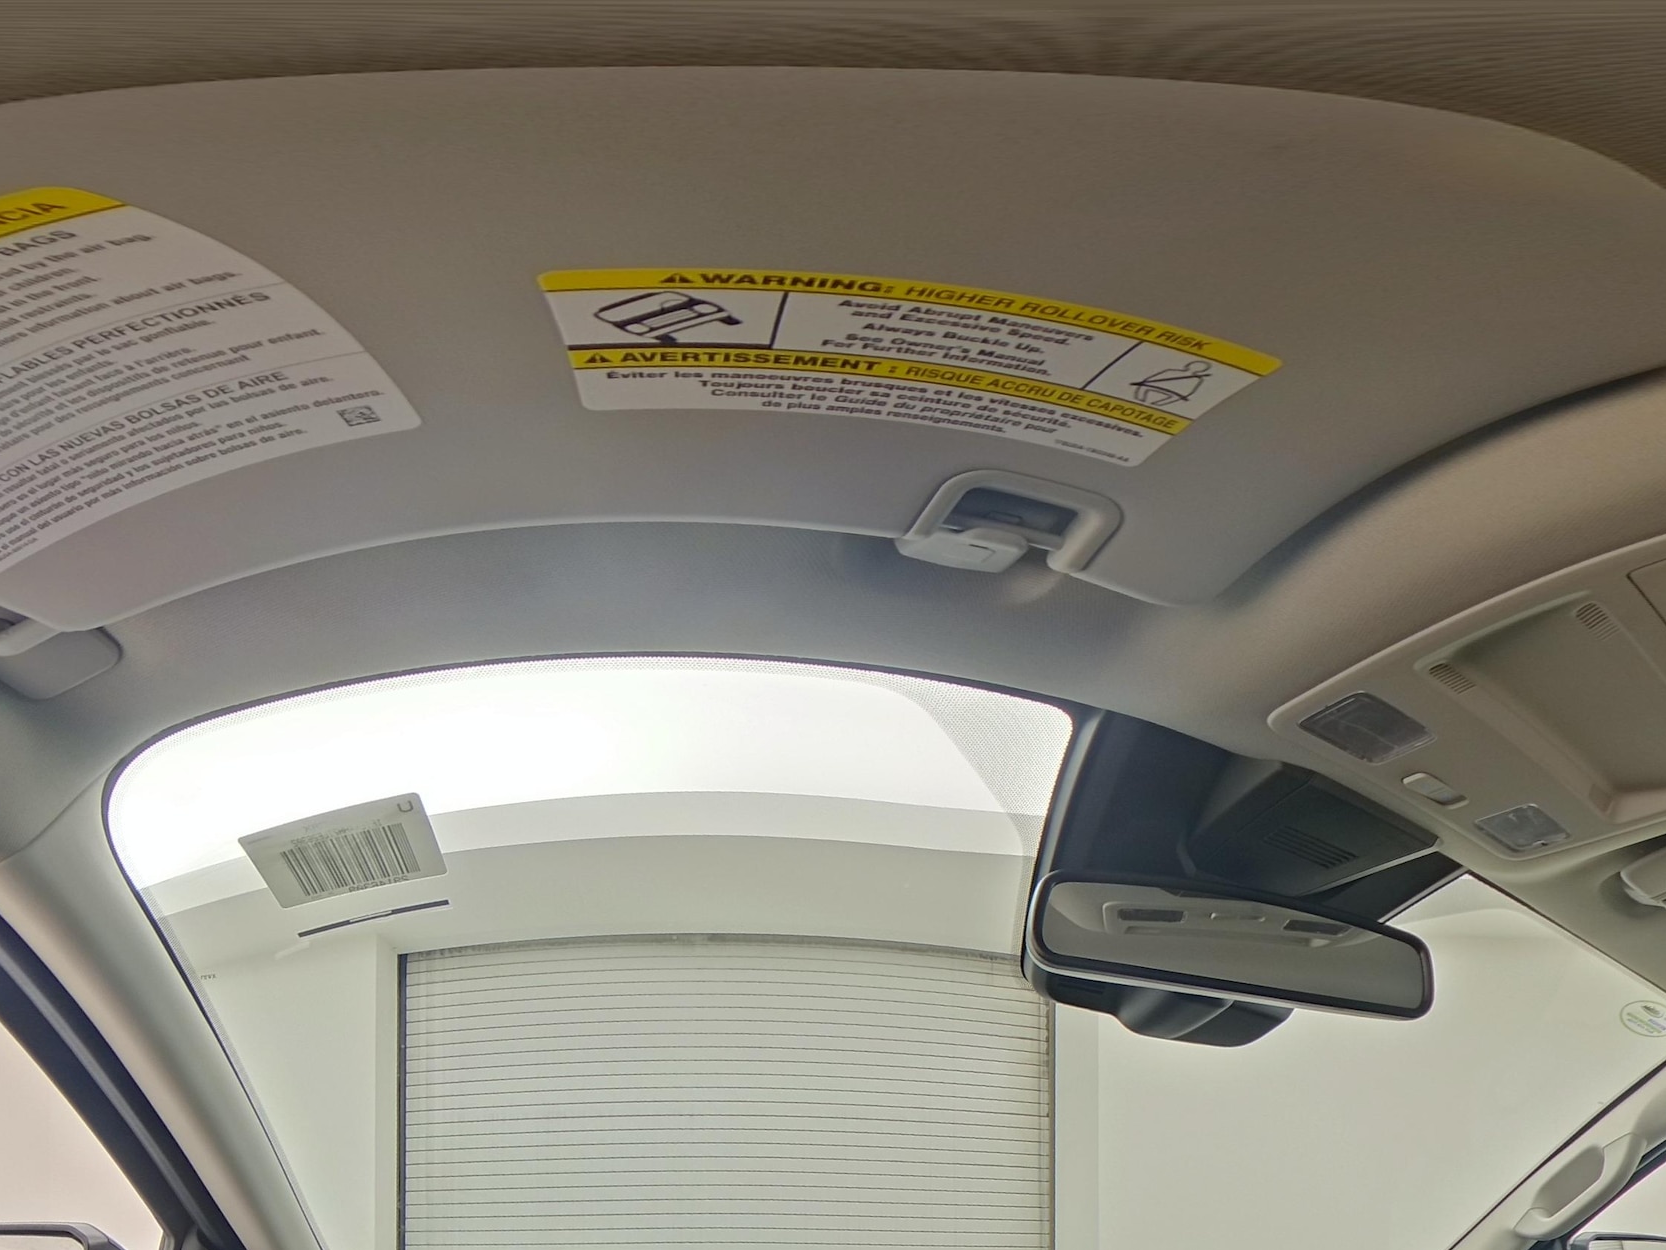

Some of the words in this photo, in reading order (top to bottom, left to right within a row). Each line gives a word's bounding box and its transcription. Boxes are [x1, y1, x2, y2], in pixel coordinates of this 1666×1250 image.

[69, 290, 271, 349] PERFECTIONNÉS
[700, 273, 895, 293] WARNING:
[904, 286, 1016, 308] HIGHER
[1018, 301, 1157, 336] ROLLOVER
[1154, 330, 1211, 350] RISK
[837, 299, 902, 311] Avoid
[907, 306, 983, 321] Abrupt
[986, 316, 1097, 341] Maneuvers
[850, 308, 893, 319] and
[898, 313, 1003, 333] Excessive
[1005, 328, 1075, 346] Speed.
[820, 339, 854, 348] For
[861, 342, 937, 357] Further
[941, 351, 1056, 376] Information.
[844, 333, 885, 344] See
[888, 337, 972, 355] Owner's
[976, 349, 1046, 366] Manual
[861, 322, 937, 337] Always
[941, 331, 1011, 347] Buckle
[1012, 342, 1049, 355] Up.
[605, 370, 665, 379] Éviter
[710, 372, 834, 383] manoeuvres
[839, 378, 928, 394] brusques
[932, 388, 953, 396] et
[956, 391, 985, 401] les
[987, 397, 1057, 415] vitesses
[1059, 412, 1147, 438] excessives.
[618, 352, 880, 371] AVERTISSEMENT
[905, 366, 984, 385] RISQUE
[985, 377, 1057, 398] ACCRU
[1055, 391, 1085, 404] DE
[1084, 397, 1178, 429] CAPOTAGE
[699, 380, 784, 391] Toujours
[790, 383, 864, 397] boucler
[868, 390, 891, 398] sa
[895, 392, 972, 408] ceinture
[975, 403, 999, 413] de
[1001, 408, 1075, 428] sécurité.
[710, 388, 804, 399] Consulter
[810, 393, 827, 401] le
[833, 394, 888, 406] Guide
[892, 400, 917, 410] du
[919, 404, 1023, 427] propriétaire
[1023, 423, 1057, 435] pour
[26, 447, 61, 466] LAS
[56, 420, 126, 451] NUEVAS
[122, 393, 203, 424] BOLSAS
[200, 384, 234, 398] DE
[233, 371, 288, 390] AIRE
[761, 399, 782, 407] de
[786, 401, 821, 411] plus
[825, 404, 882, 416] amples
[885, 410, 1009, 434] renseignements.
